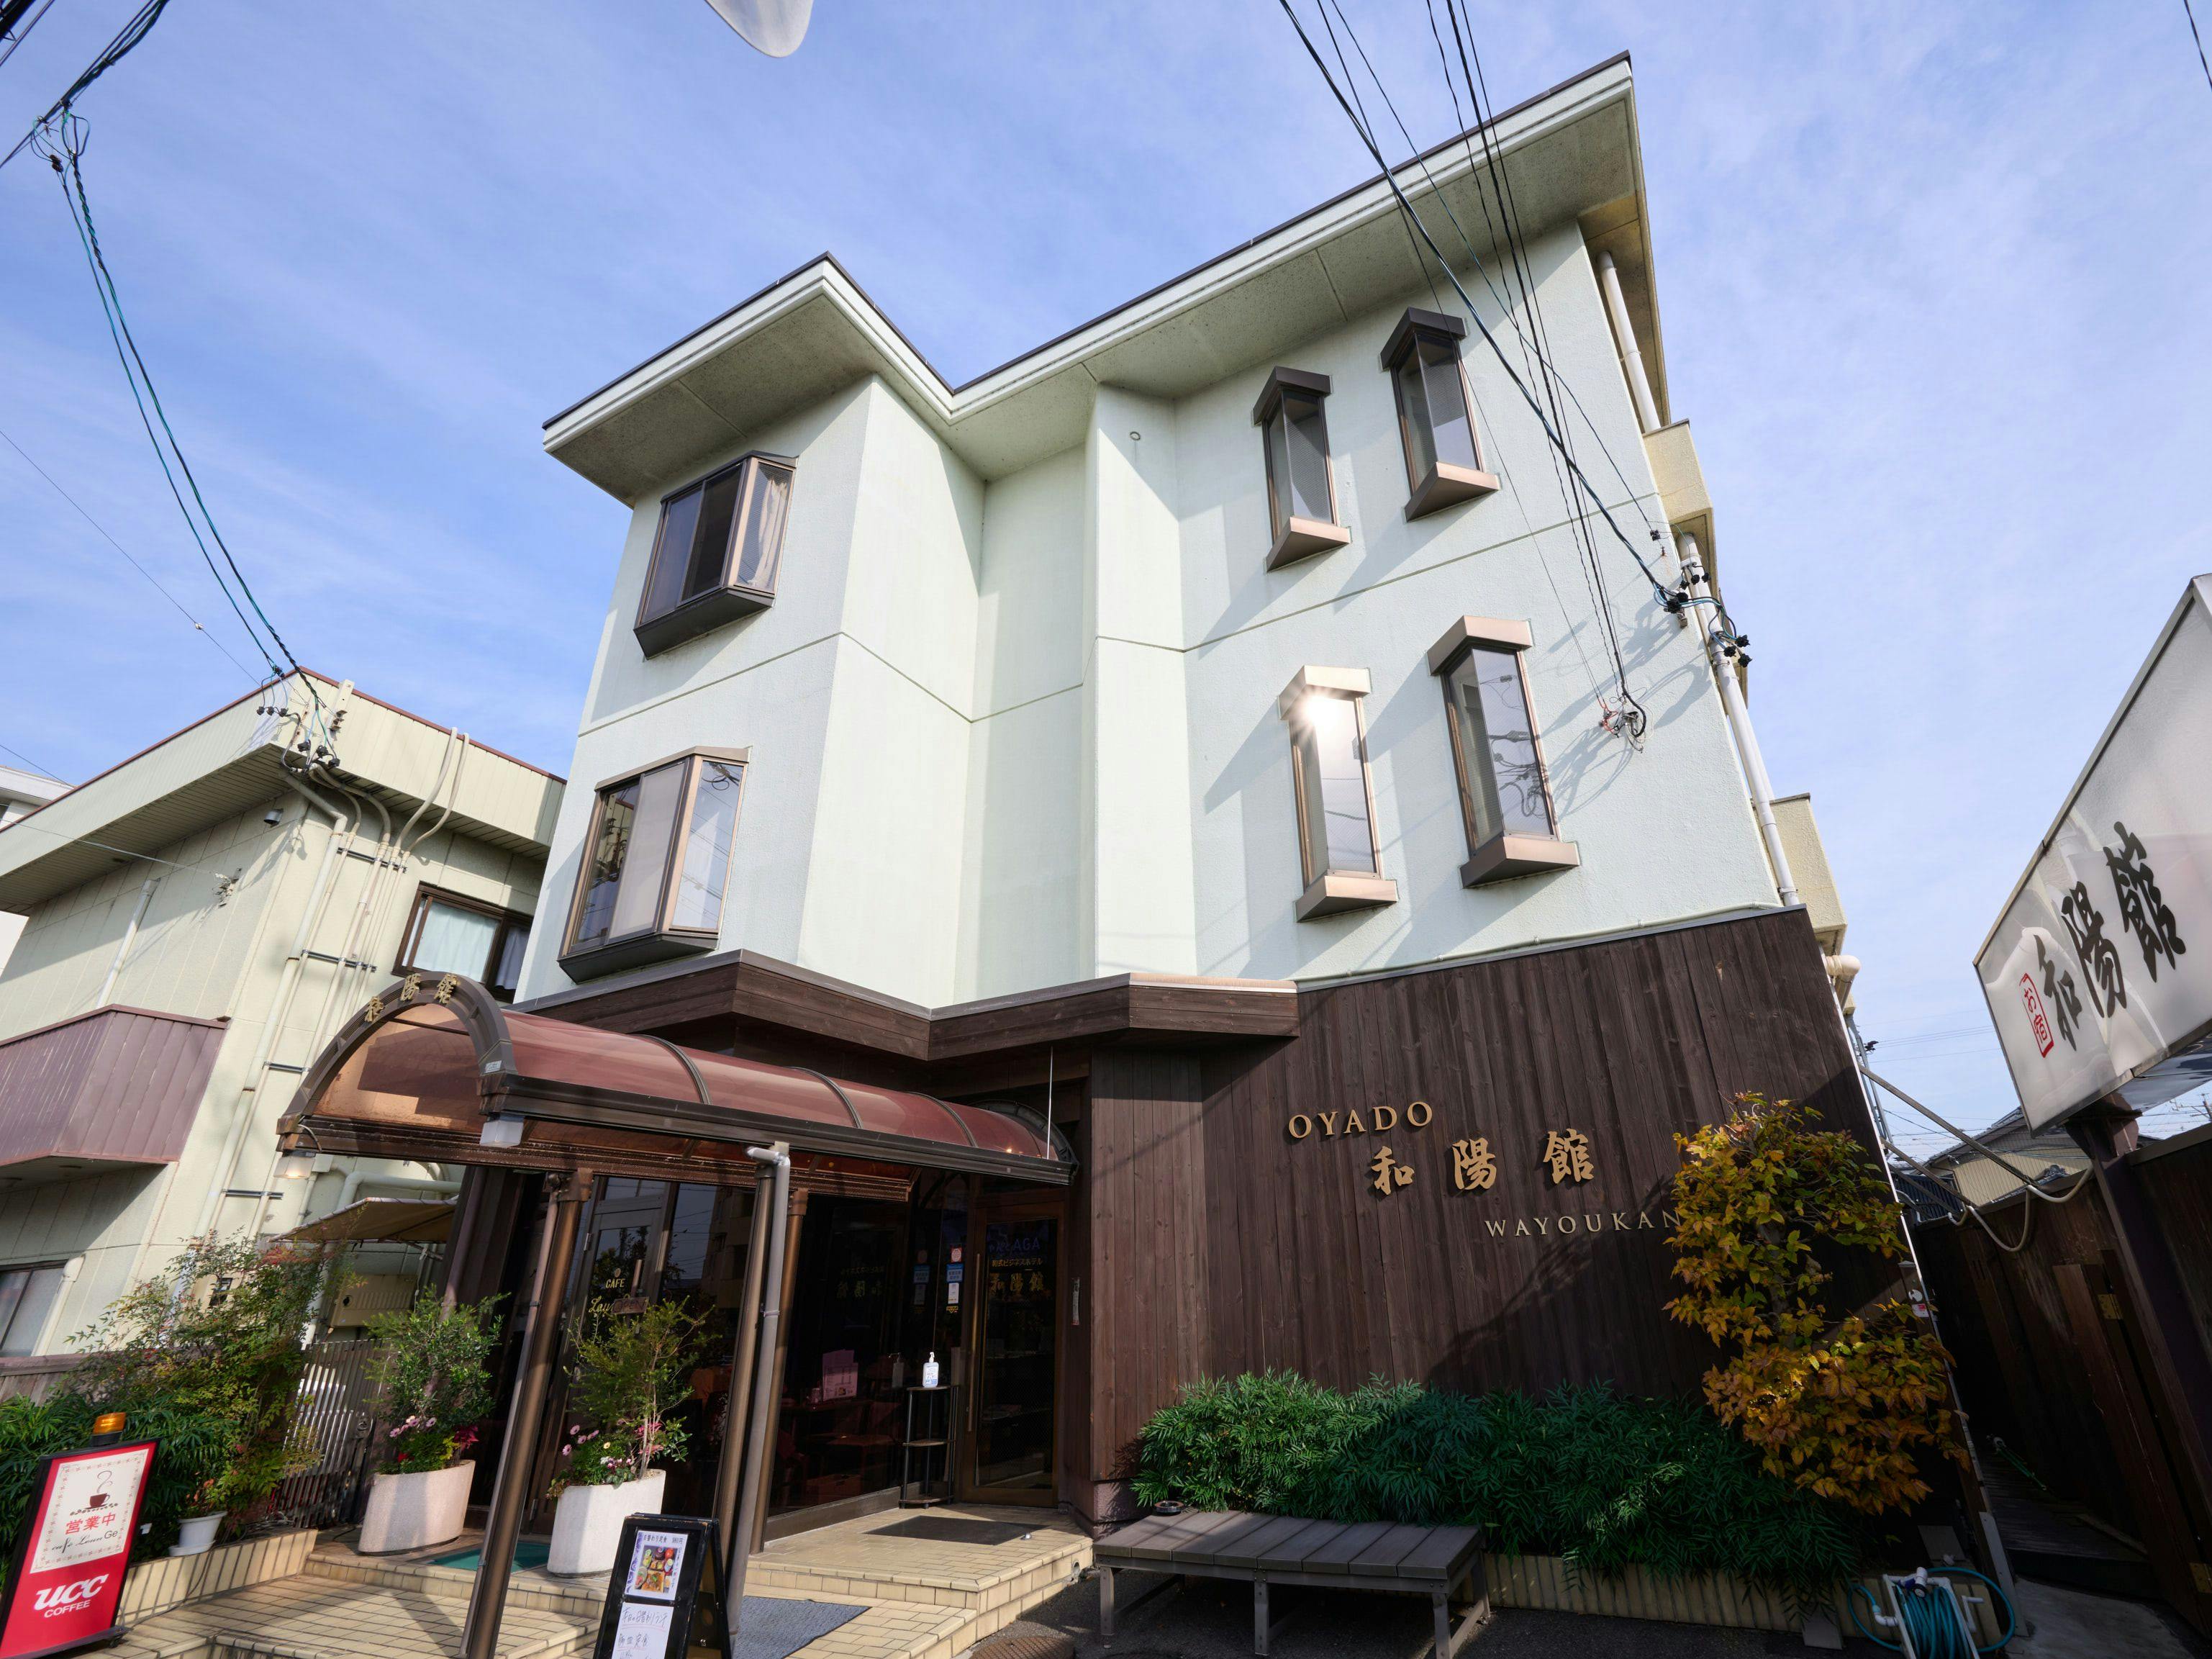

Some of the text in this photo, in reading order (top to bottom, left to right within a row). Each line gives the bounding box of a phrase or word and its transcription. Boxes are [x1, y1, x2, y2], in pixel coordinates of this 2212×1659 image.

[2034, 821, 2185, 1052] 和陽館
[1288, 1101, 1433, 1139] OYADO
[1372, 1128, 1595, 1195] 和陽館
[1485, 1209, 1682, 1238] WAYOUKAN
[605, 1278, 626, 1289] CAFE
[65, 1512, 116, 1534] 営業中
[34, 1573, 109, 1611] UCC
[44, 1599, 91, 1618] COFFEE
